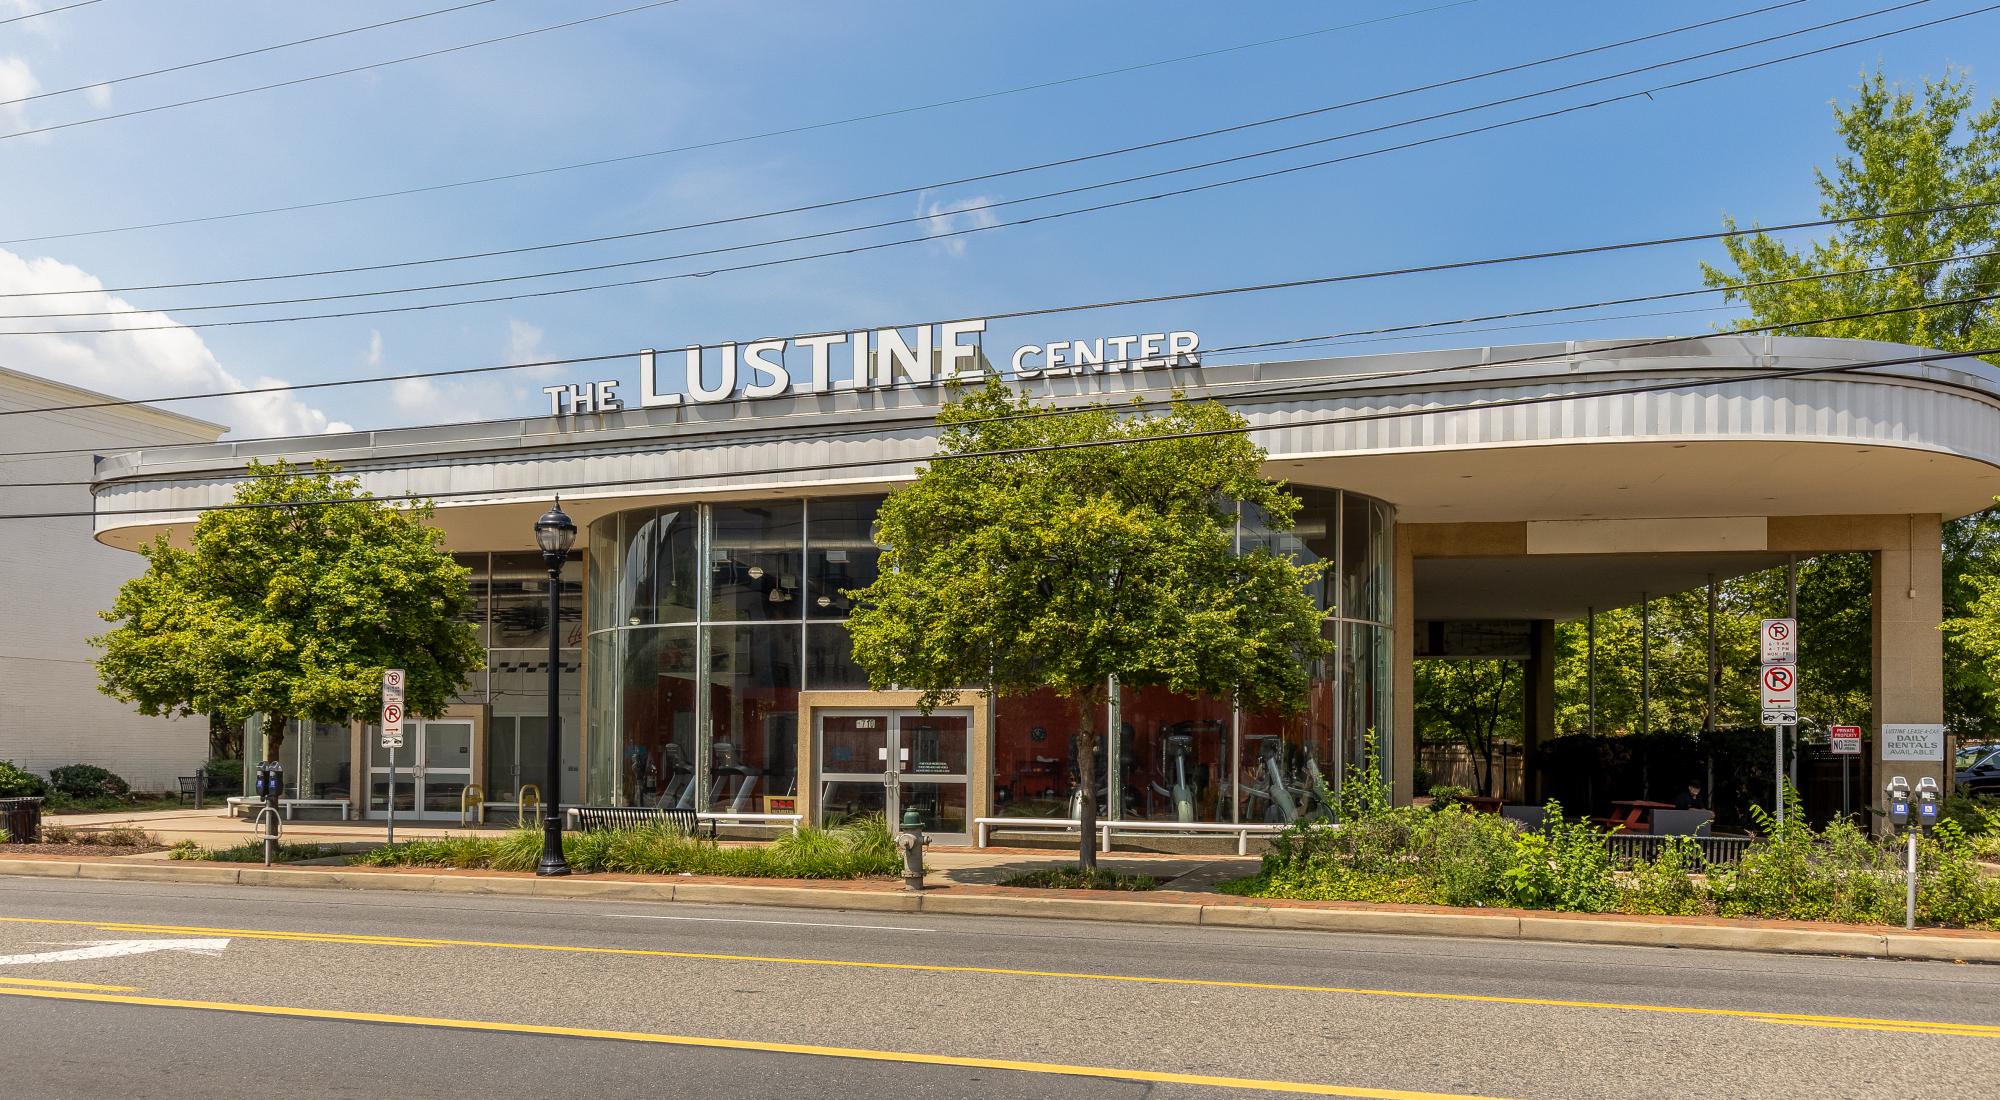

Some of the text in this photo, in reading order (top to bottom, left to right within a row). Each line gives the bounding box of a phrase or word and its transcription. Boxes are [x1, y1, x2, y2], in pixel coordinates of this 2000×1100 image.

[543, 318, 1201, 416] THE LUSTINE CENTER
[1833, 740, 1843, 750] NO
